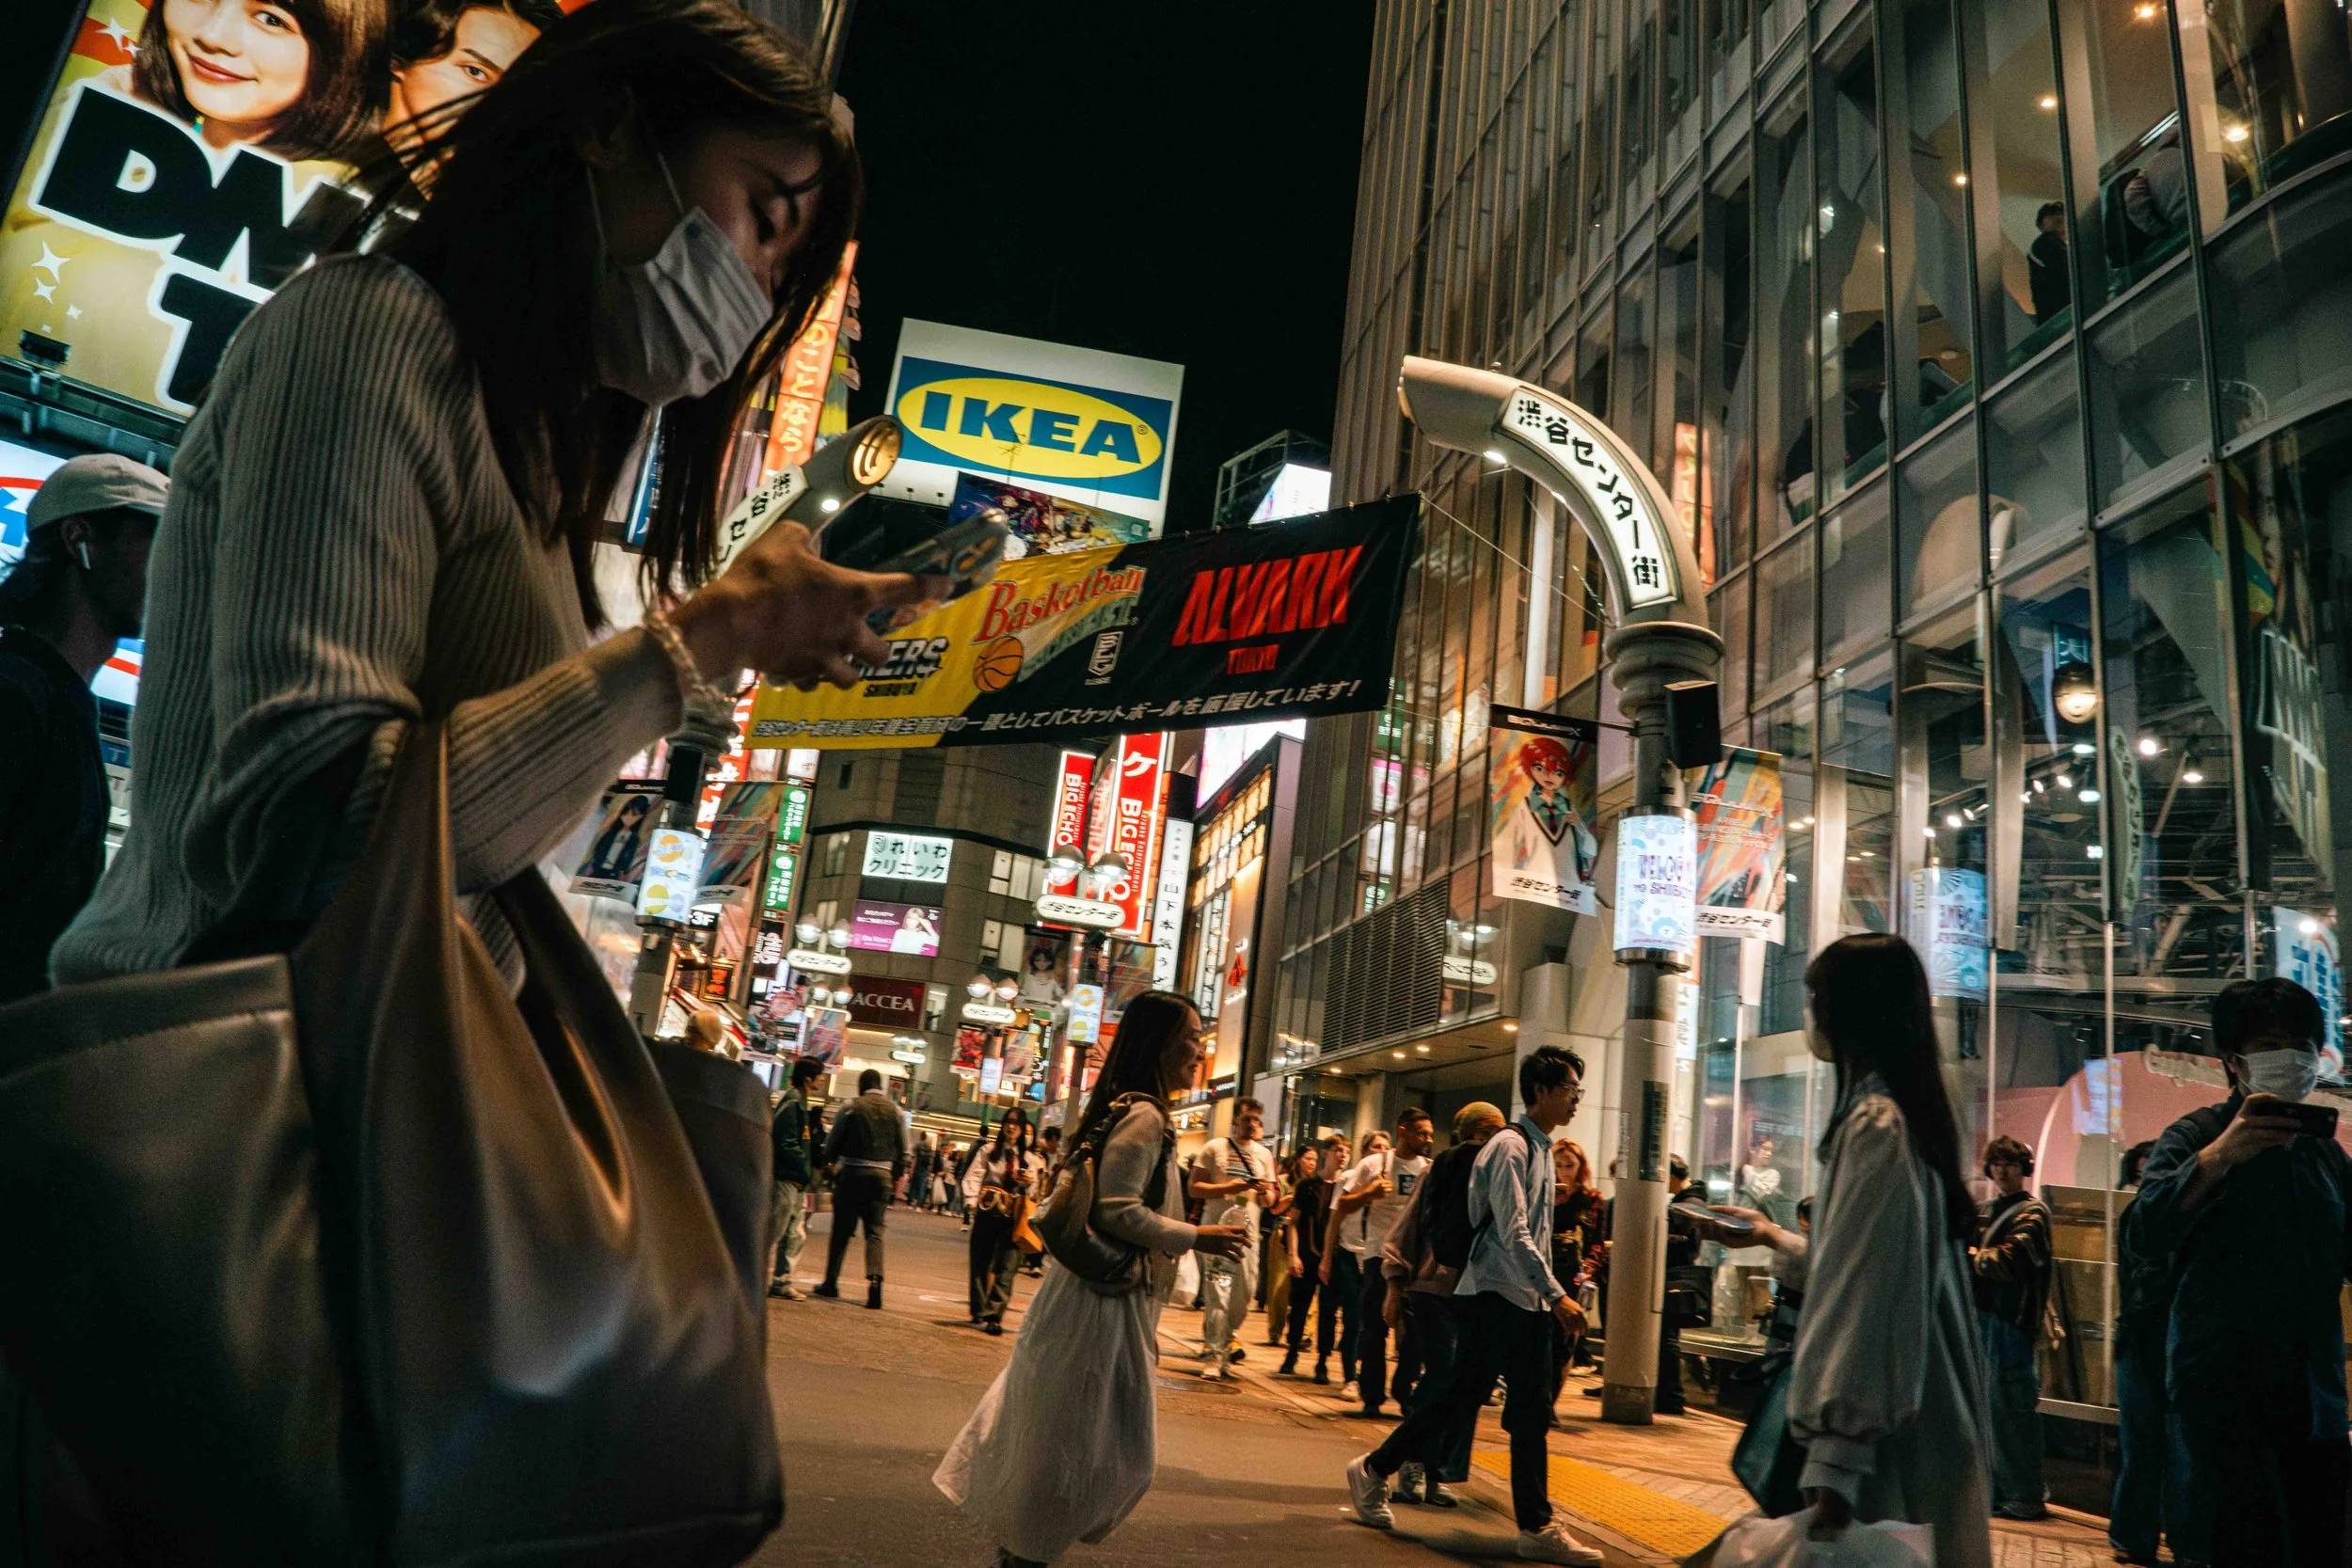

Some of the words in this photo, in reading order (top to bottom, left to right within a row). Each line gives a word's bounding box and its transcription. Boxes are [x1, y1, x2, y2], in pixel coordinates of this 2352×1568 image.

[920, 390, 1143, 464] IKEA
[1517, 397, 1661, 590] 渋谷センター街
[970, 564, 1148, 646] Basketball
[1170, 545, 1363, 647] ALVARK
[1064, 773, 1083, 804] BIG
[1057, 804, 1078, 846] ECHO
[1119, 797, 1143, 836] BIG
[868, 858, 945, 879] クリニック
[891, 840, 947, 859] れいわ
[1109, 840, 1136, 902] ECO
[1510, 875, 1582, 900] 渋谷センター街
[852, 991, 915, 1013] ACCEA
